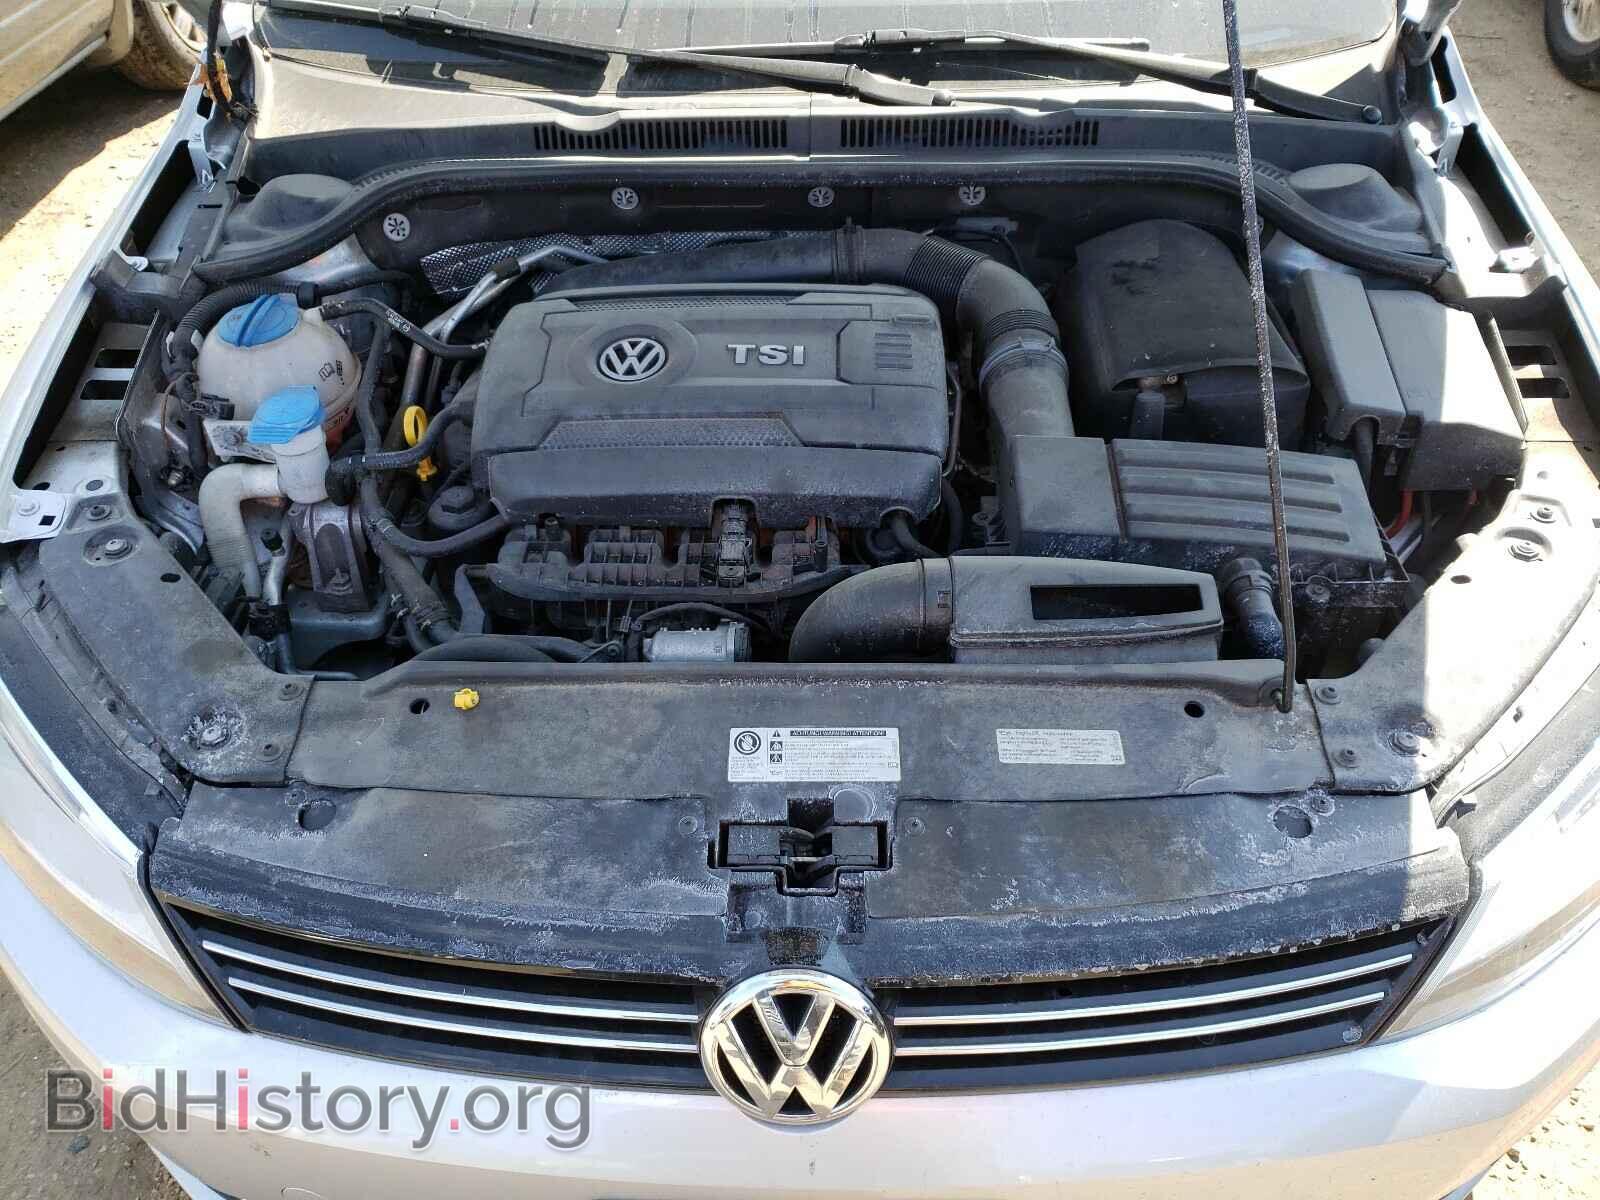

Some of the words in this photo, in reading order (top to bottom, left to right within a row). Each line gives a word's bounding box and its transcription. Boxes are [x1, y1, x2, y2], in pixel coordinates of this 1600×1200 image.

[601, 338, 665, 381] VW
[727, 344, 805, 365] TSI
[708, 984, 886, 1120] VW
